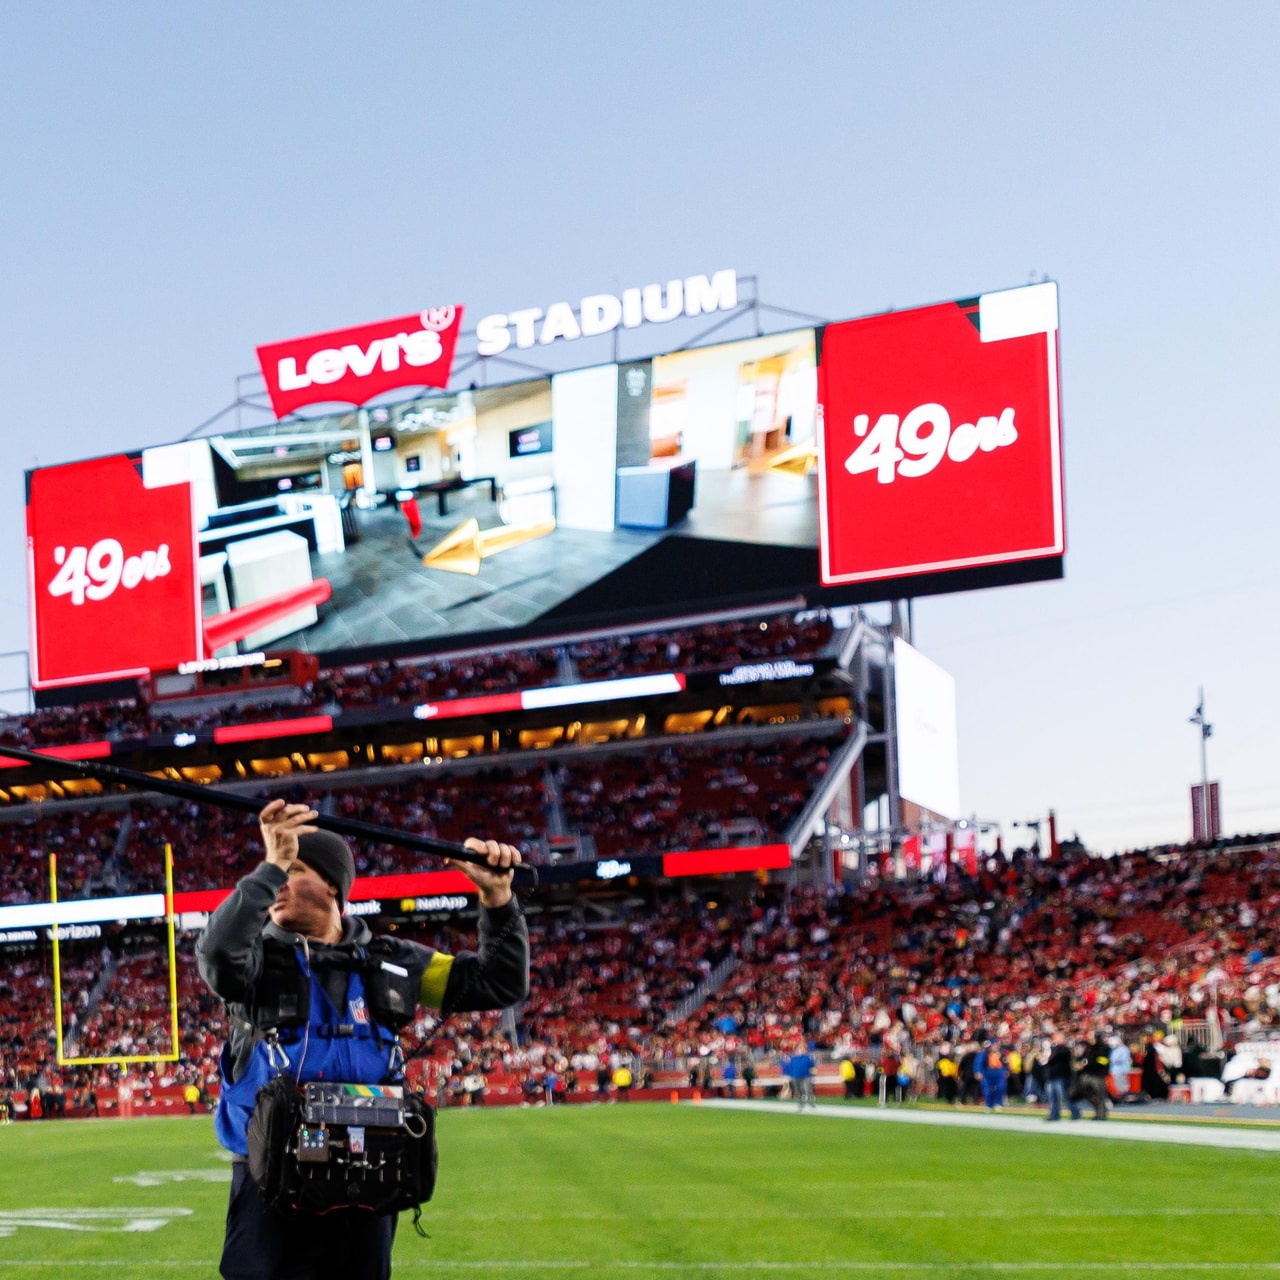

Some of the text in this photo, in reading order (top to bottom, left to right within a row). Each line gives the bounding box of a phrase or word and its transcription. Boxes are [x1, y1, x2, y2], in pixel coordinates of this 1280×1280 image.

[475, 269, 739, 356] STADIUM
[415, 895, 468, 912] NetApp
[47, 924, 102, 941] verizon
